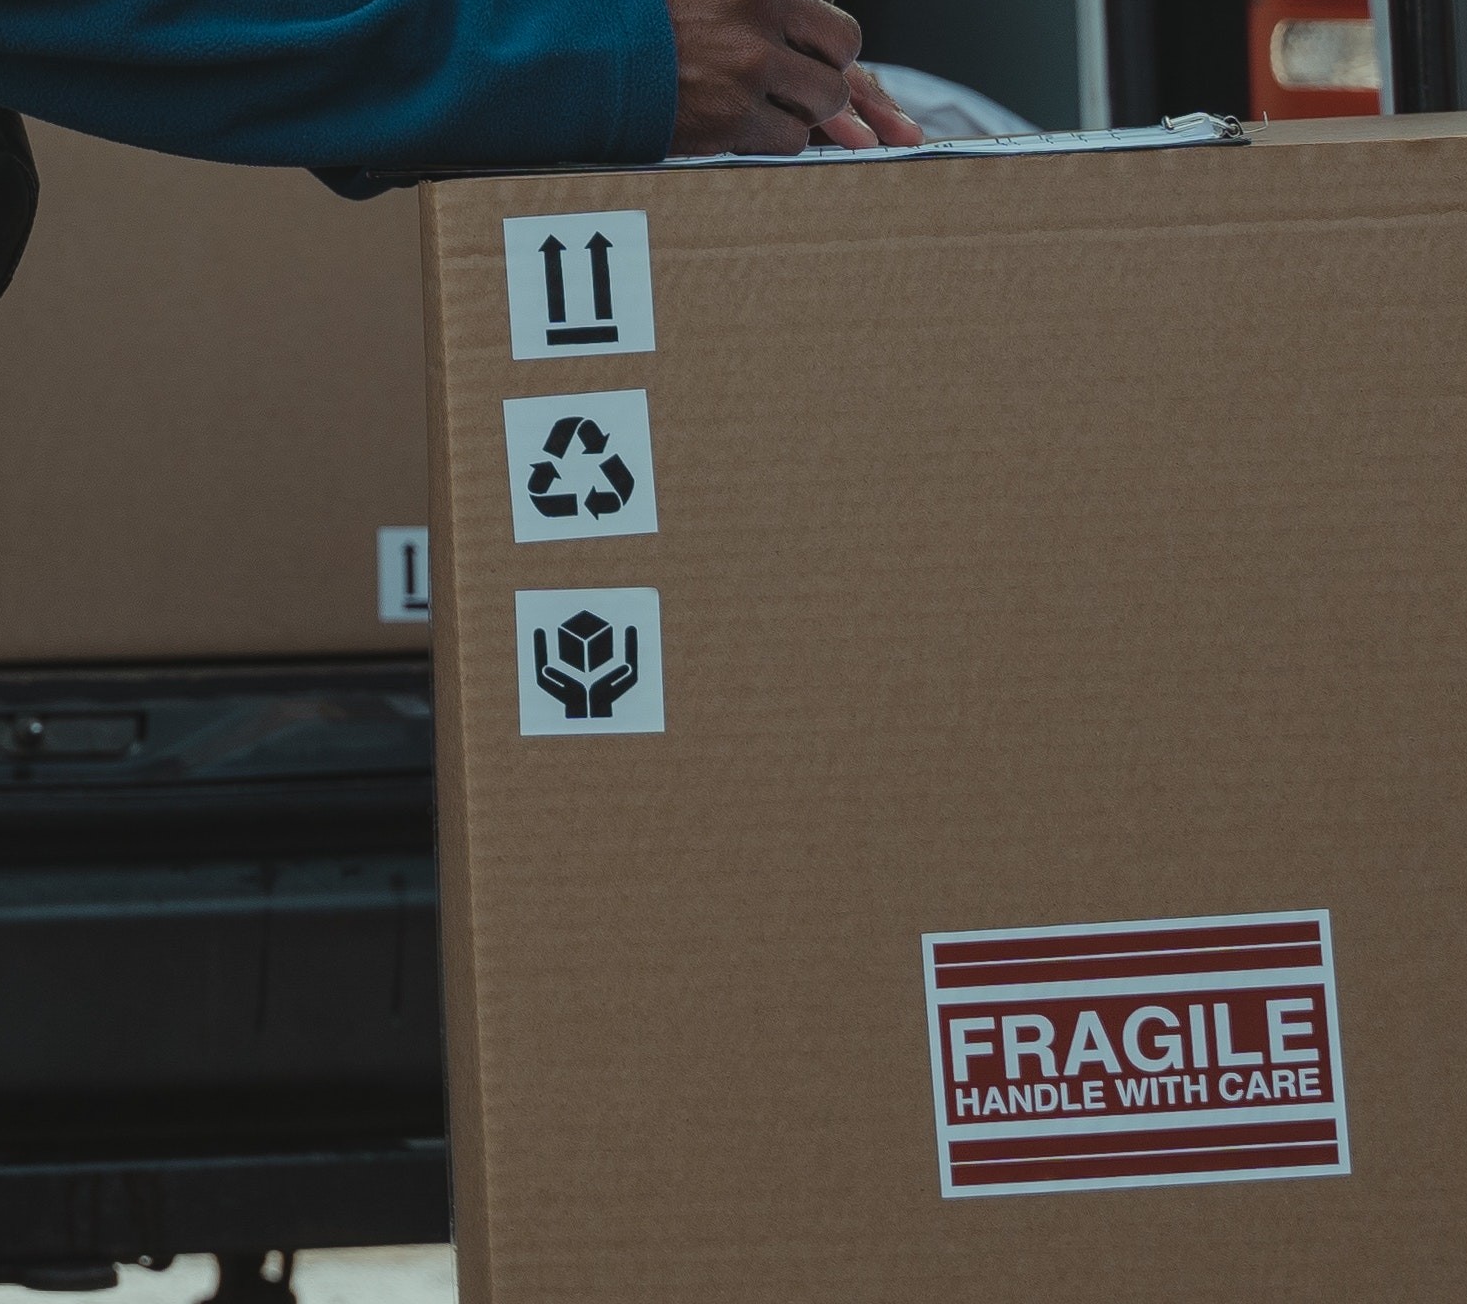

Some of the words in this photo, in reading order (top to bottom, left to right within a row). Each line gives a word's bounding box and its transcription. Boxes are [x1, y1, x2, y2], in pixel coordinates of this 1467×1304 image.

[949, 998, 1319, 1082] FRAGILE
[955, 1081, 1105, 1116] HANDLE
[1115, 1073, 1208, 1106] WITH
[1219, 1068, 1321, 1102] CARE
